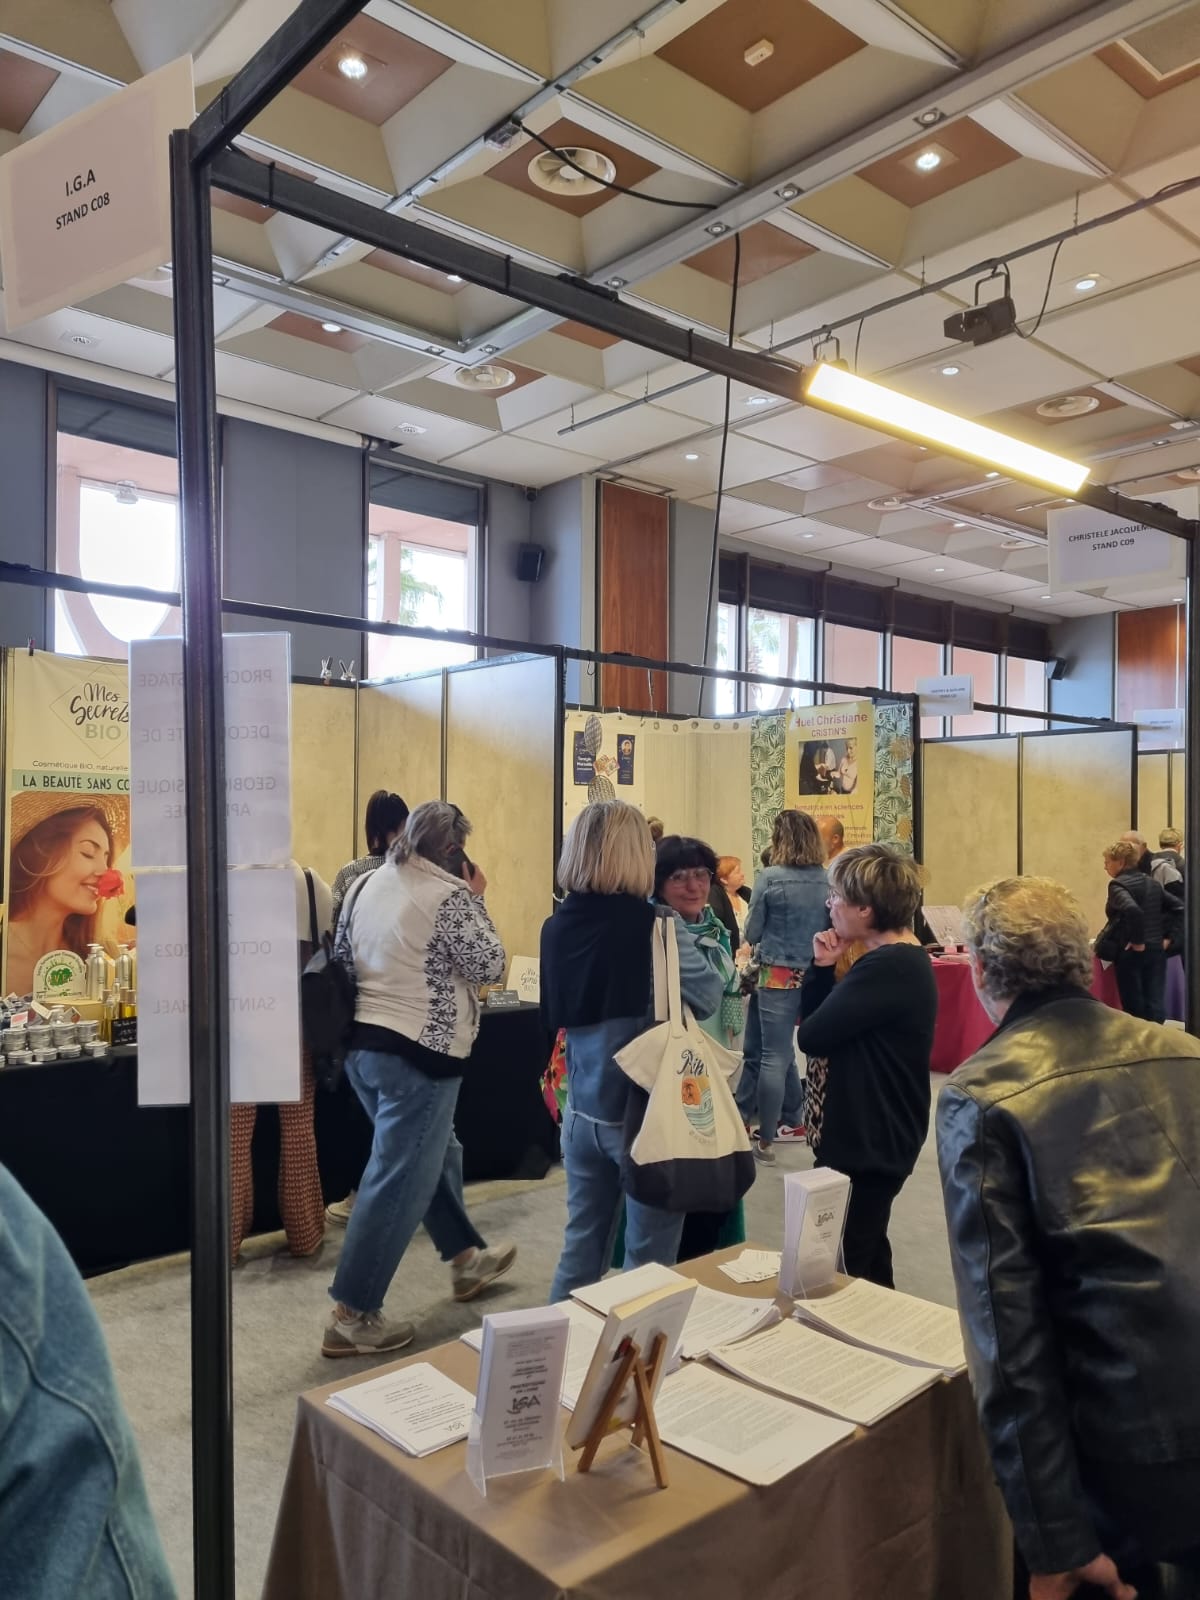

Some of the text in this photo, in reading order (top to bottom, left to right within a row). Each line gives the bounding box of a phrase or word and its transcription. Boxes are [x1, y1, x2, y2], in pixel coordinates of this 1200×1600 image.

[65, 168, 96, 197] I.G.A
[55, 191, 111, 231] STAND C08
[1068, 529, 1108, 543] CHRISTELE
[1092, 537, 1135, 551] STAND C09
[83, 682, 121, 703] Mes
[816, 712, 868, 726] Christiane
[85, 723, 121, 741] BIO
[811, 727, 847, 738] CRISTIN'S
[32, 760, 78, 769] Cosmétique
[22, 774, 37, 788] LA
[43, 774, 82, 789] BEAUTÉ
[87, 777, 112, 790] SANS
